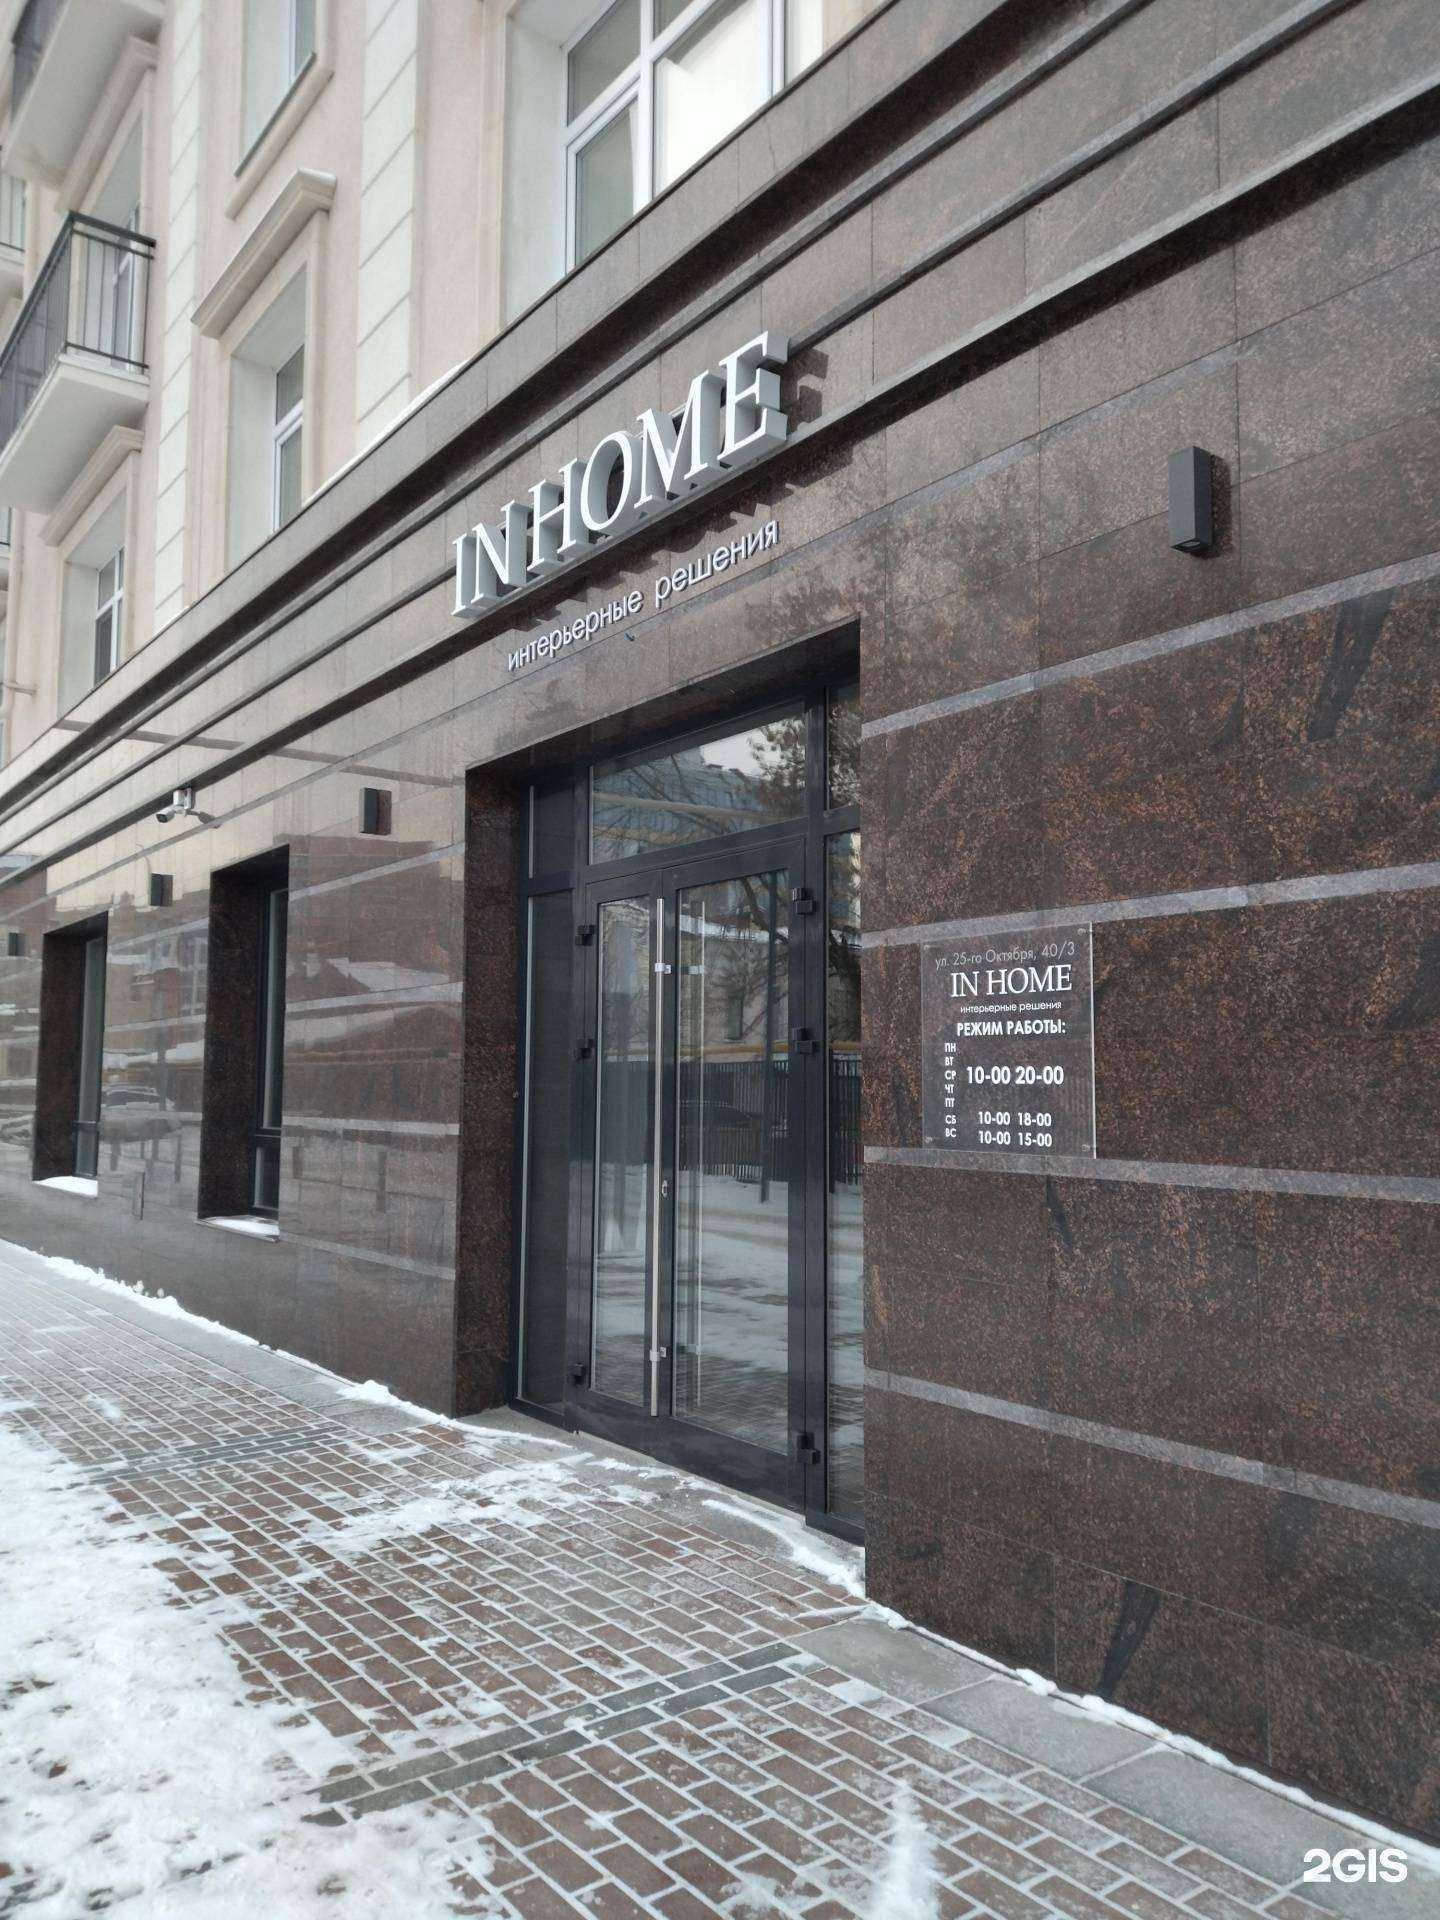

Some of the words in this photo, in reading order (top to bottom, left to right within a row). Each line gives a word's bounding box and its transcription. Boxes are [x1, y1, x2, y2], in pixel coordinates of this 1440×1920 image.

[507, 589, 645, 671] интерьерные
[655, 519, 780, 608] решения
[935, 957, 950, 971] ул.
[953, 952, 983, 966] 25-го
[985, 946, 1037, 963] Октября,
[1041, 941, 1076, 960] 40/3
[950, 971, 980, 998] IN
[986, 964, 1072, 995] HOME
[960, 1002, 1017, 1015] интерьерные
[1019, 1001, 1063, 1013] решения
[957, 1021, 1004, 1037] РЕЖИМ
[1006, 1019, 1067, 1036] РАБОТЫ:
[944, 1042, 957, 1053] ПН
[944, 1057, 954, 1067] ВТ
[944, 1070, 957, 1081] СР
[966, 1066, 1011, 1085] 10-00
[1015, 1065, 1065, 1085] 20-00
[944, 1084, 955, 1094] ЧТ
[944, 1098, 956, 1108] ПТ
[945, 1115, 957, 1125] СБ
[978, 1111, 1011, 1126] 10-00
[1018, 1112, 1052, 1127] 18-00
[945, 1128, 957, 1138] ВС
[978, 1131, 1011, 1145] 10-00
[1018, 1132, 1053, 1147] 15-00
